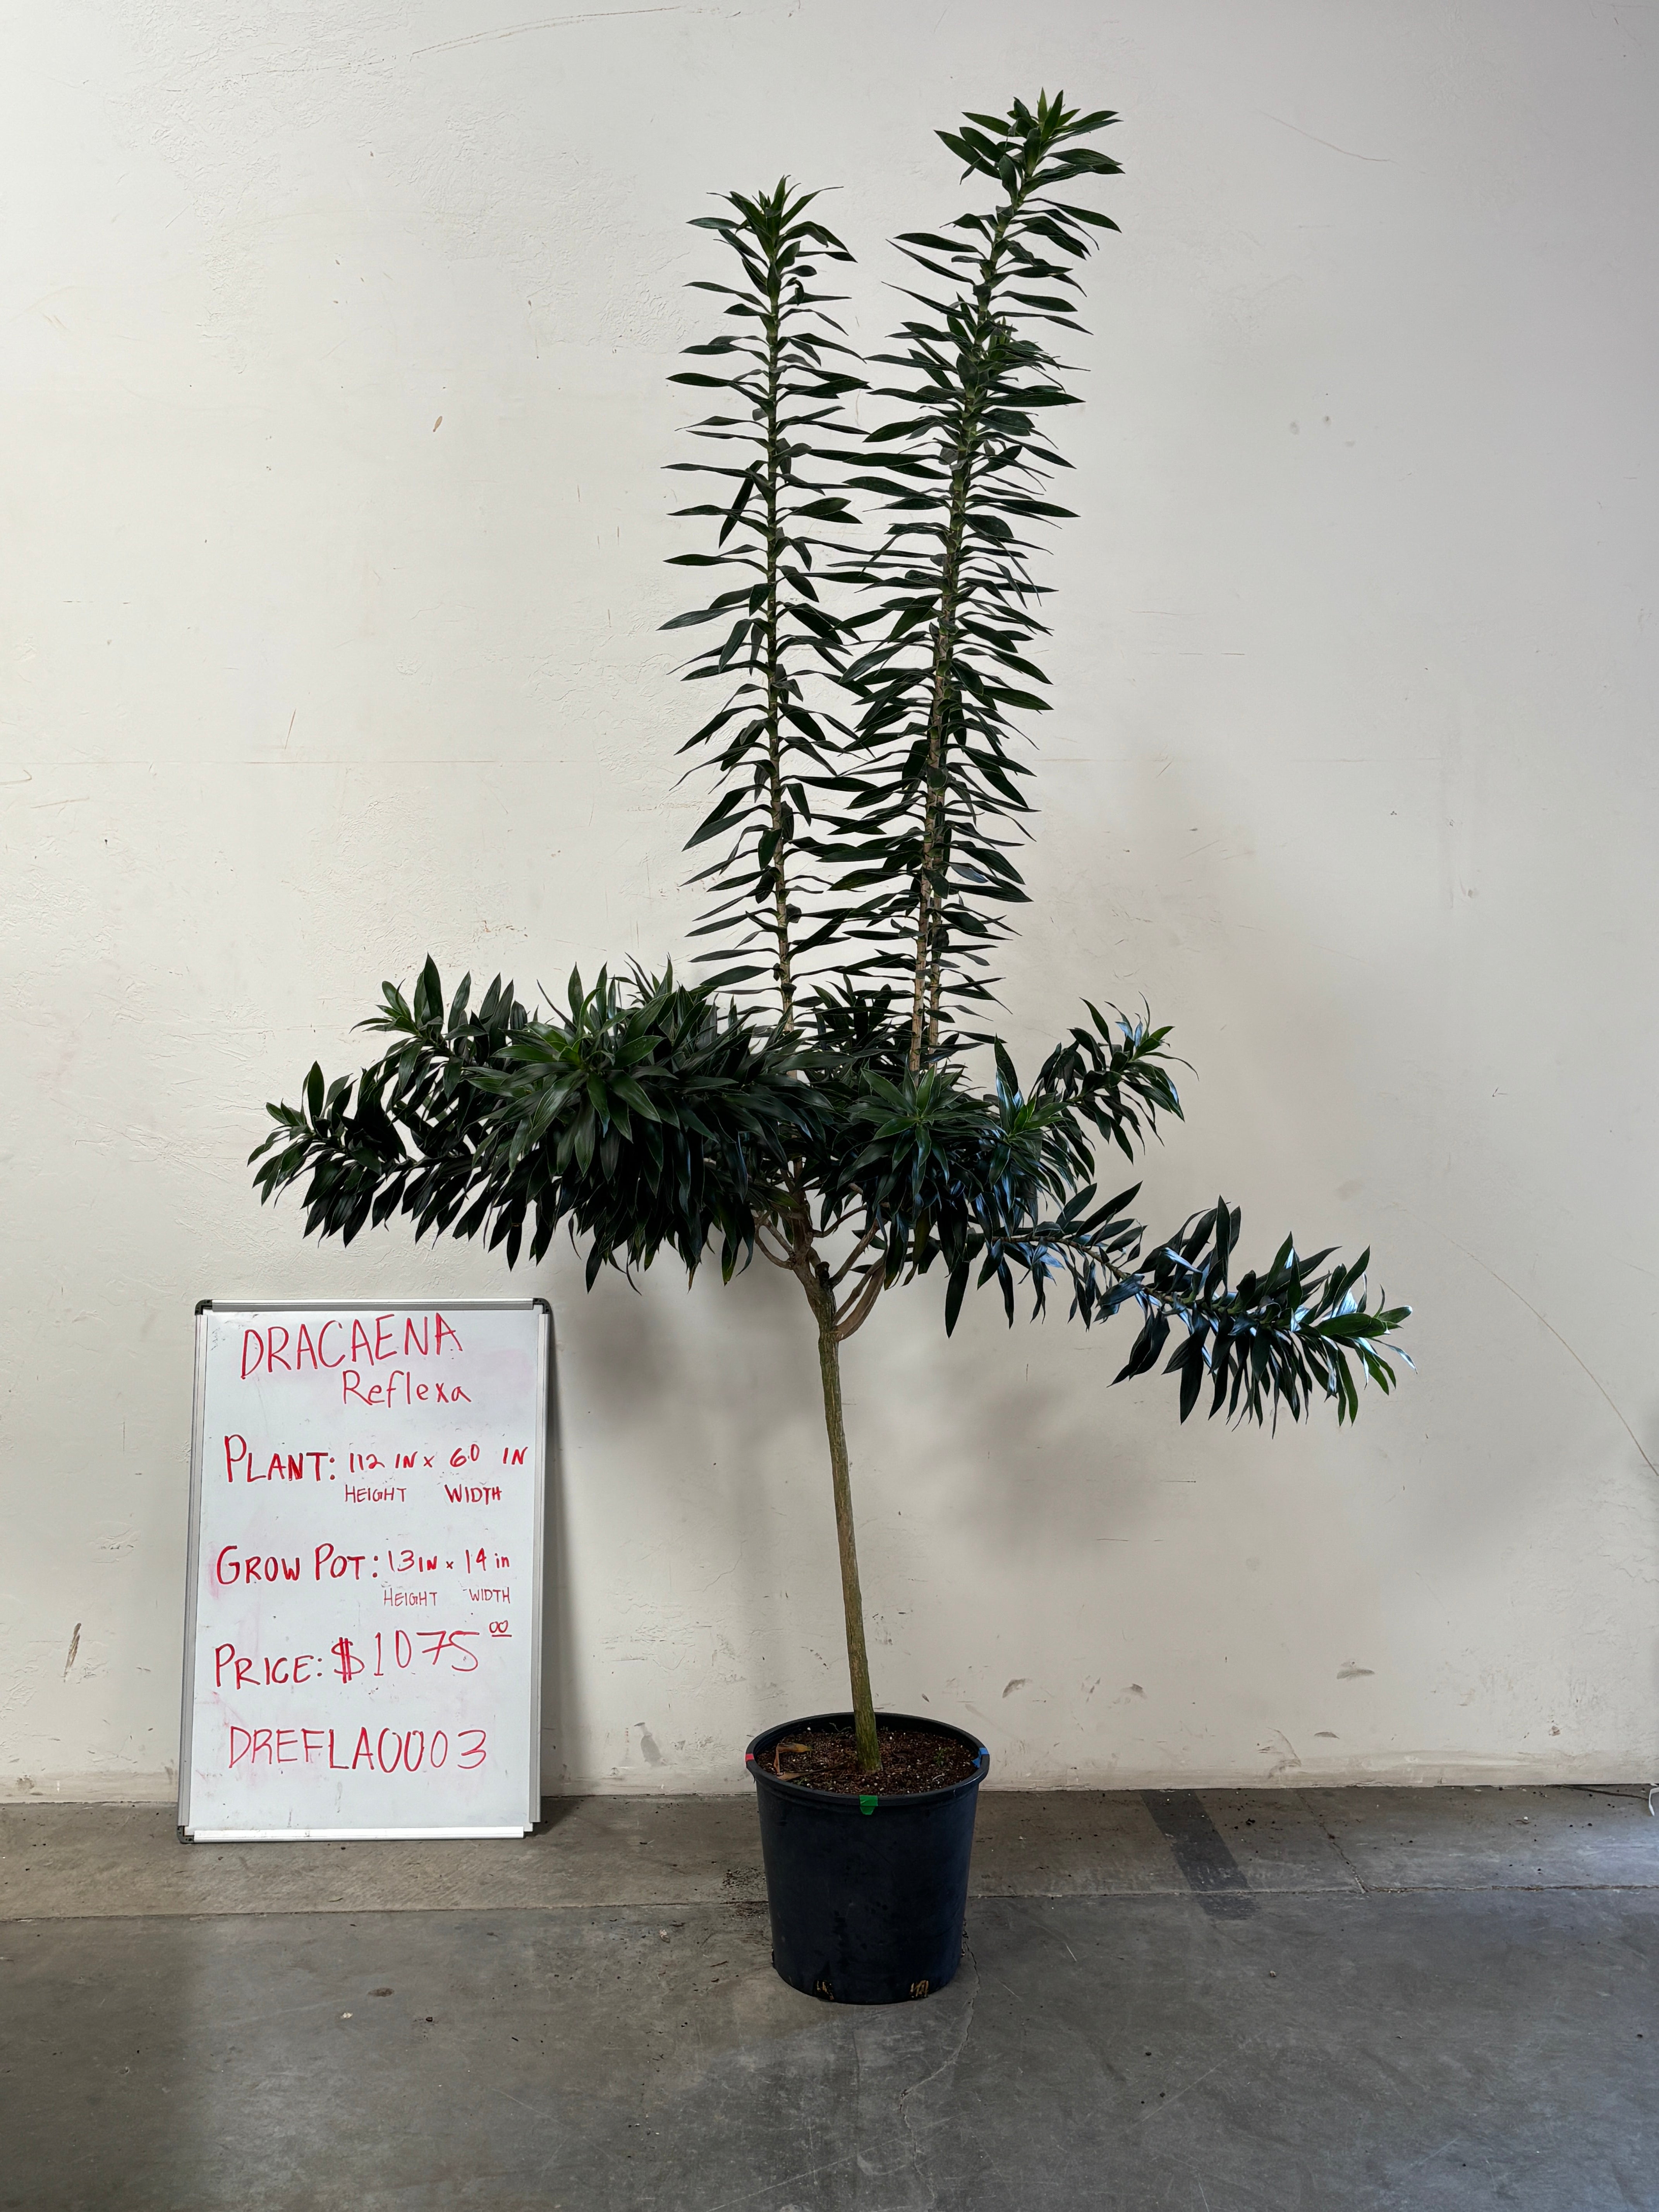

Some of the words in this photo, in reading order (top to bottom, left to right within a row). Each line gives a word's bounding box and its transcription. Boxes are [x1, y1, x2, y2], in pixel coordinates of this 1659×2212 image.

[240, 1313, 462, 1380] DRACAENA
[342, 1370, 471, 1407] Reflexa
[224, 1435, 335, 1483] PLANT:
[350, 1453, 384, 1473] 112
[394, 1452, 417, 1469] IN
[502, 1448, 527, 1465] IN
[345, 1486, 407, 1503] HEIGHT
[445, 1486, 501, 1505] WIDTH
[216, 1546, 300, 1585] GROW
[465, 1549, 487, 1573] 14
[383, 1589, 438, 1607] HEIGHT
[469, 1587, 510, 1604] WIDTH
[215, 1644, 322, 1690] PRICE:
